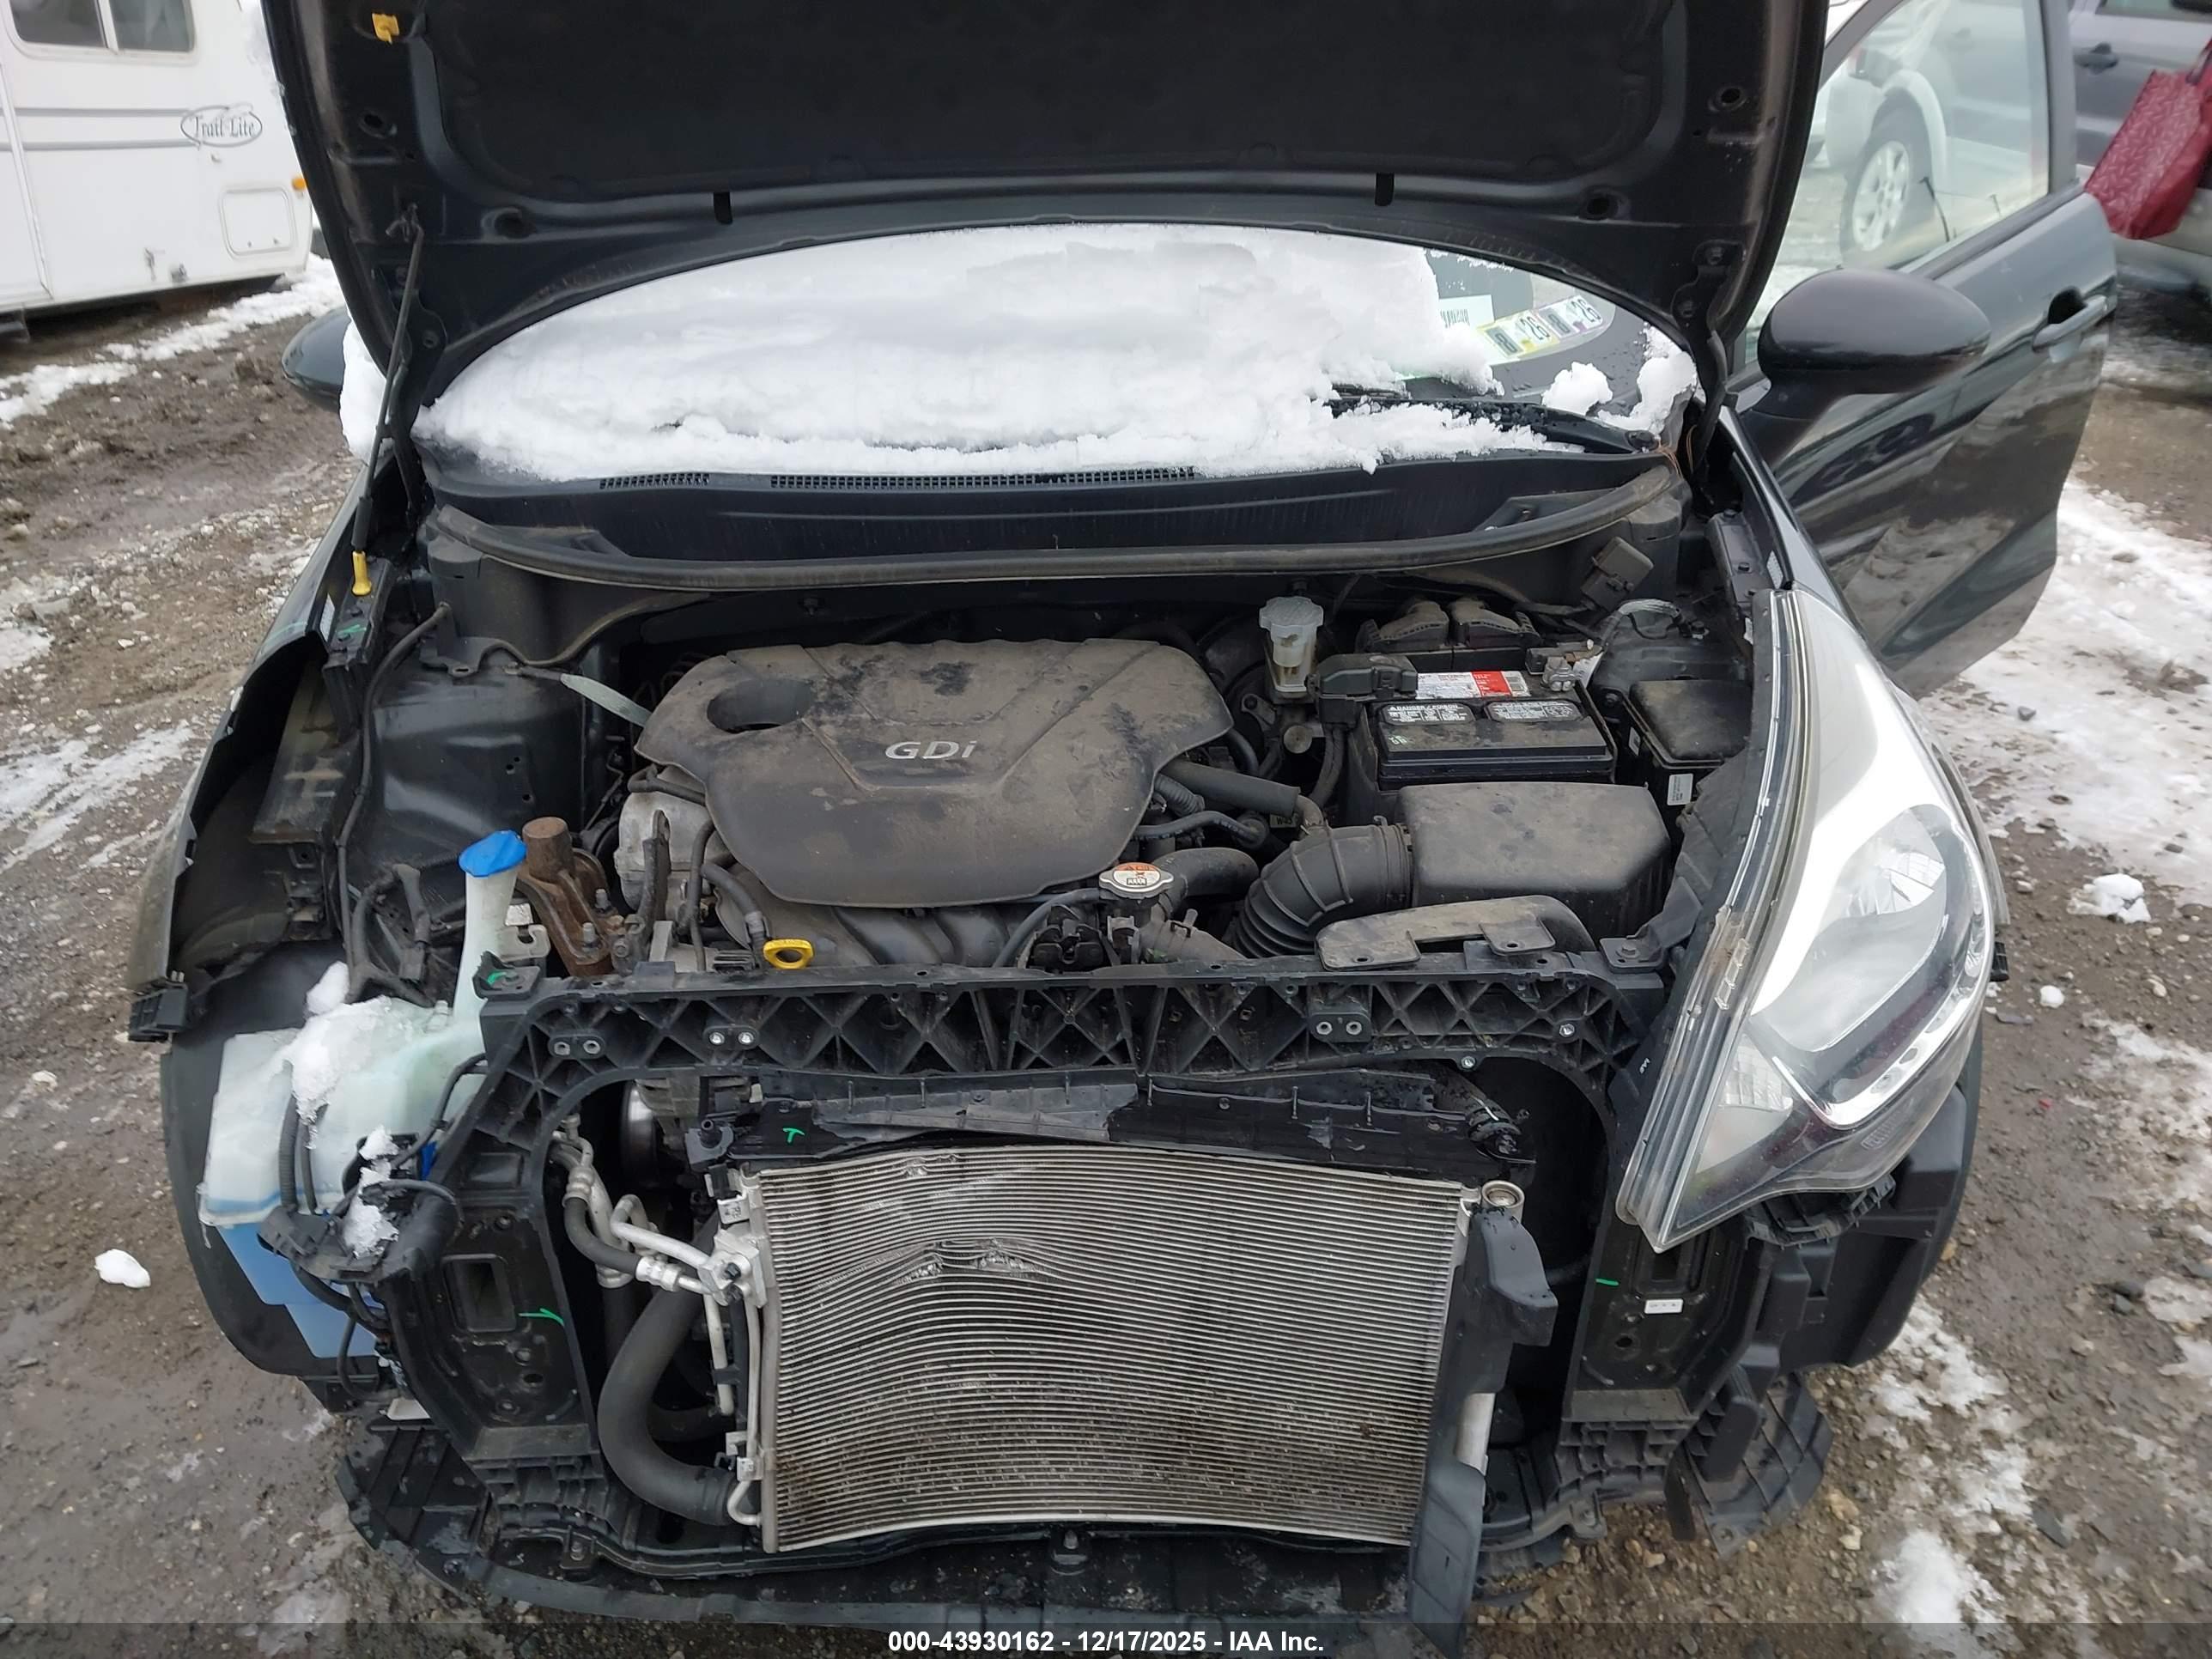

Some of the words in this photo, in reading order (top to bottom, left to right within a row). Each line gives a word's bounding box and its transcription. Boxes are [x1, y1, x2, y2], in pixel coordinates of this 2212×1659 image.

[189, 114, 223, 138] Trail
[229, 115, 258, 138] Lite
[1571, 298, 1601, 323] 26
[1519, 315, 1550, 341] 26
[885, 740, 978, 760] GDi
